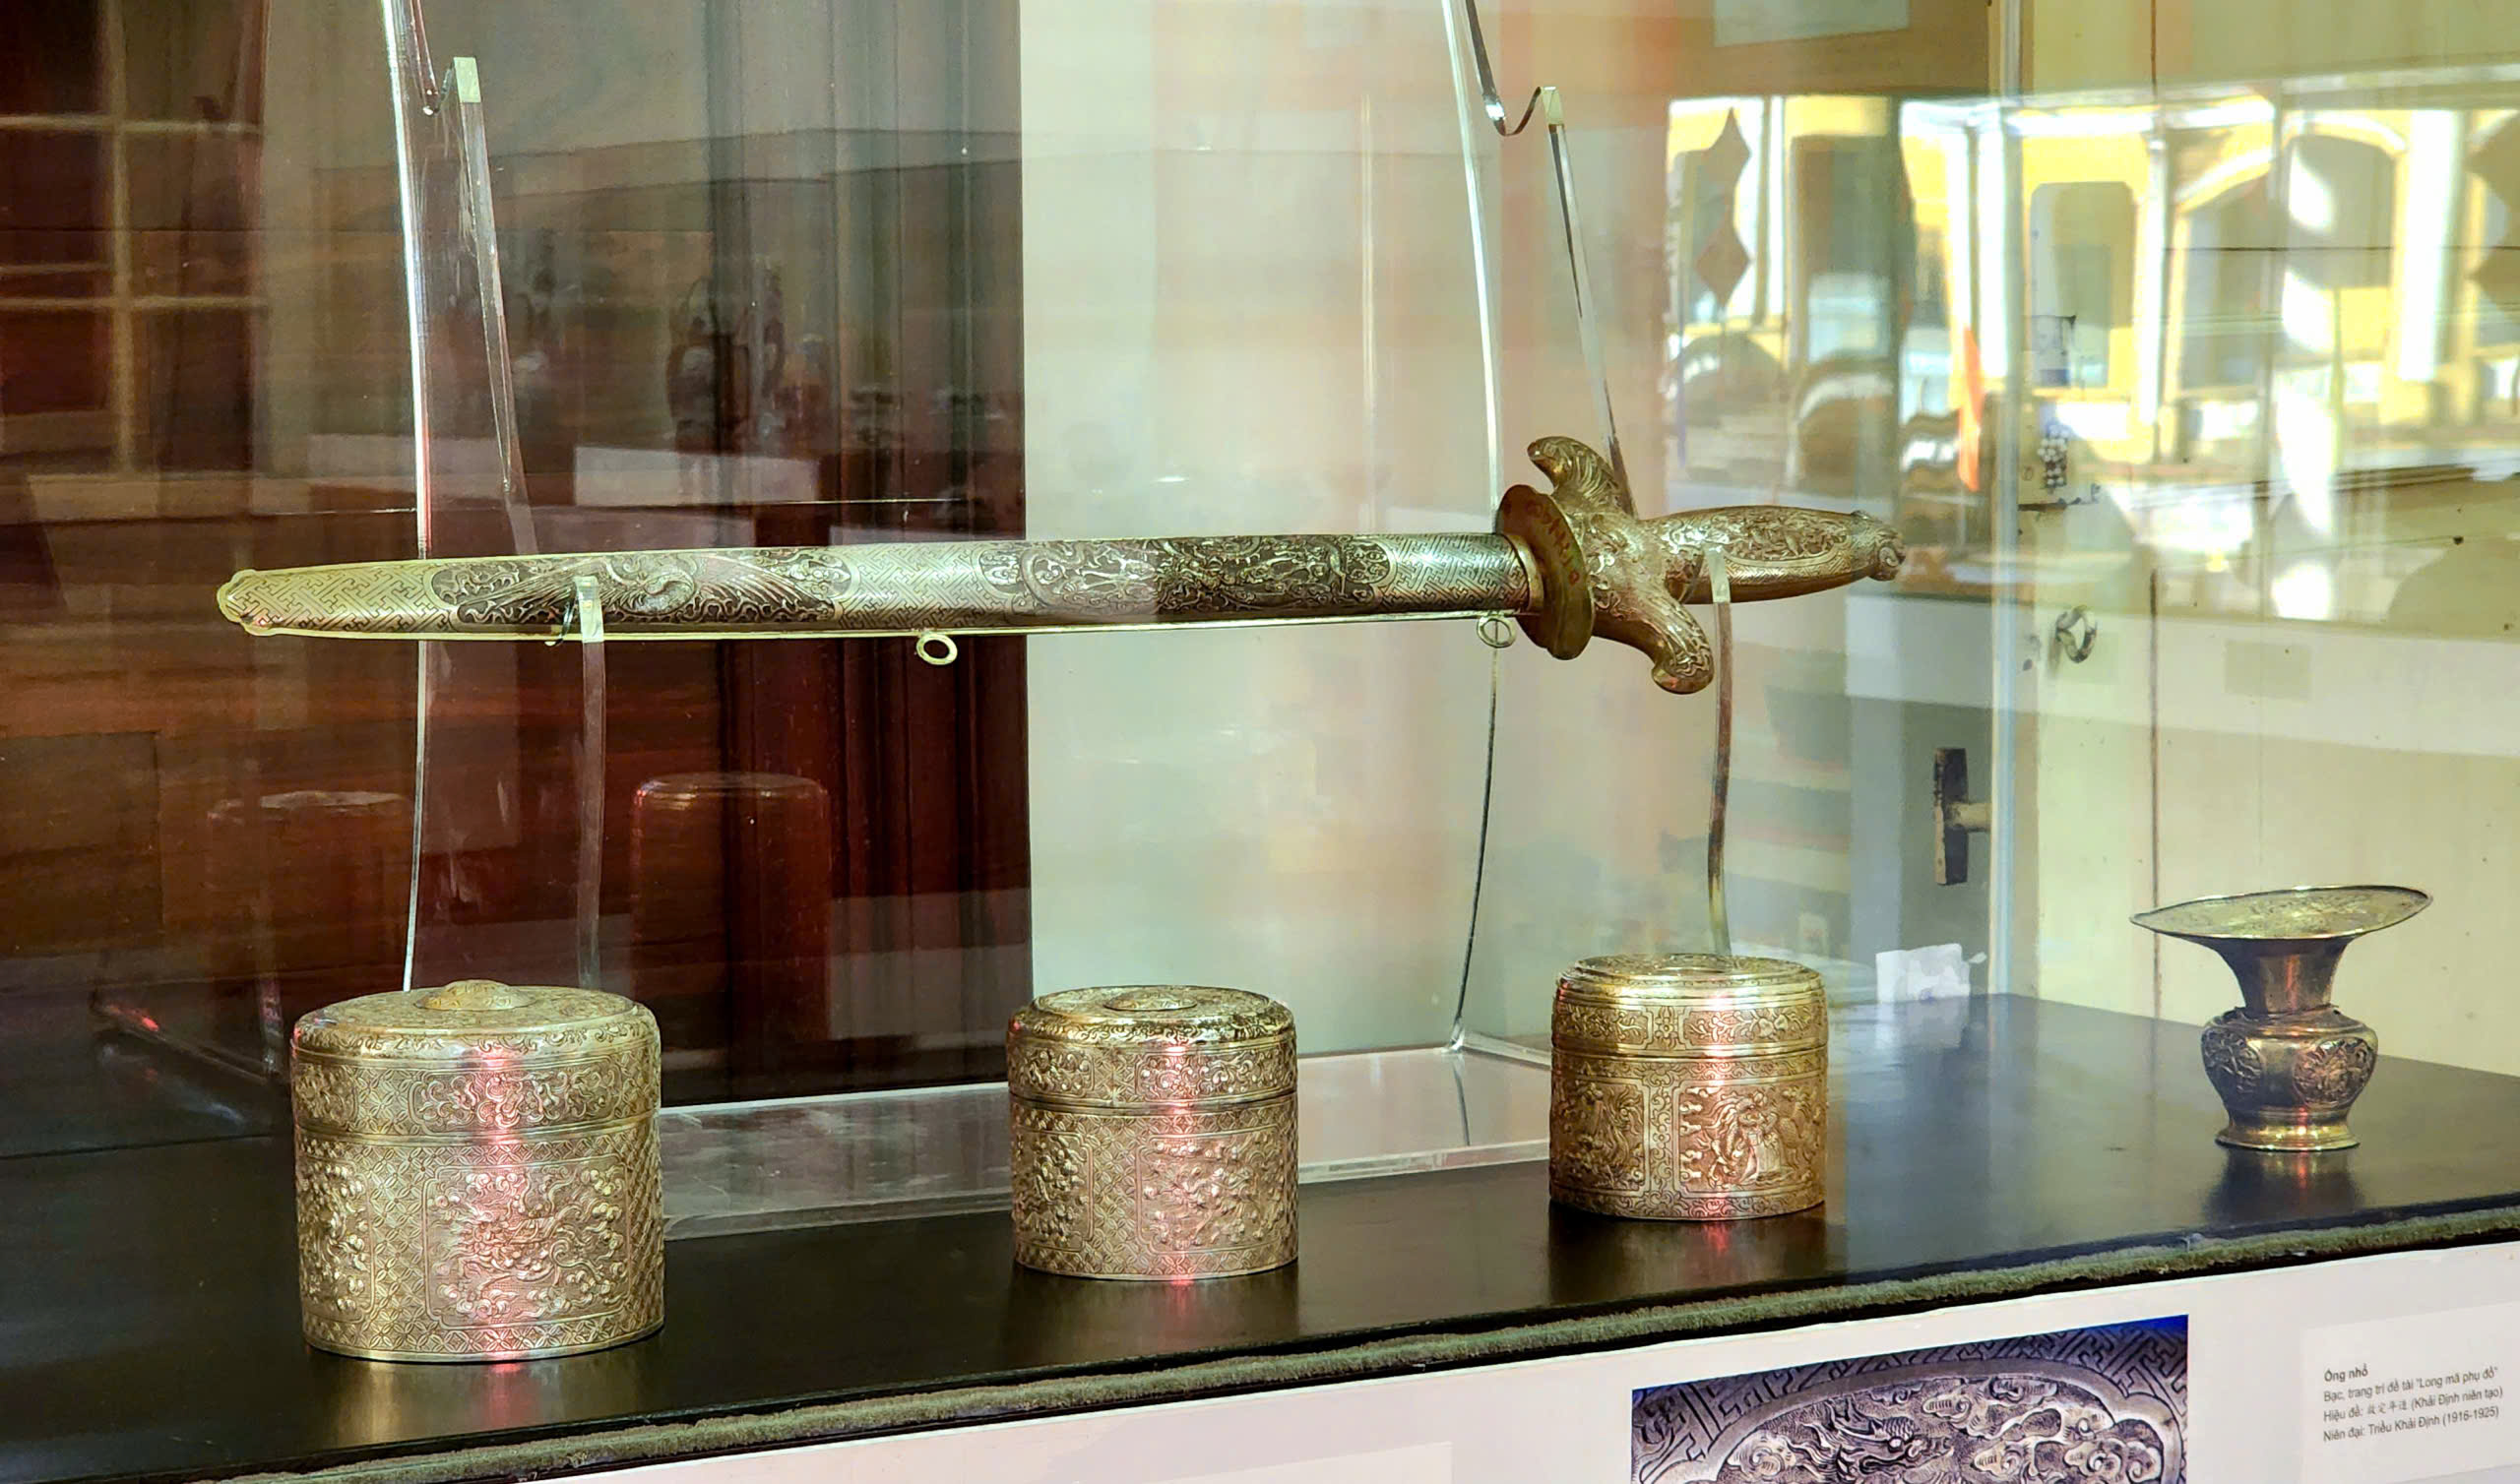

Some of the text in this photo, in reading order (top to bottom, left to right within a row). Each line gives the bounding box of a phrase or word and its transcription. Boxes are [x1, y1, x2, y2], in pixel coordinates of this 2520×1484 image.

[2348, 1387, 2372, 1398] trang
[2416, 1377, 2442, 1389] "Long
[2445, 1373, 2460, 1384] mã
[2463, 1371, 2480, 1385] phụ
[2324, 1409, 2346, 1422] Hiệu
[2411, 1394, 2436, 1411] (Khải
[2438, 1392, 2460, 1406] Định
[2462, 1389, 2482, 1400] niên
[2485, 1386, 2503, 1399] tạo)
[2324, 1429, 2346, 1442] Niên
[2368, 1420, 2391, 1435] Triều
[2395, 1417, 2416, 1432] Khải
[2419, 1415, 2440, 1428] Định
[2442, 1406, 2499, 1427] (1916-1925)
